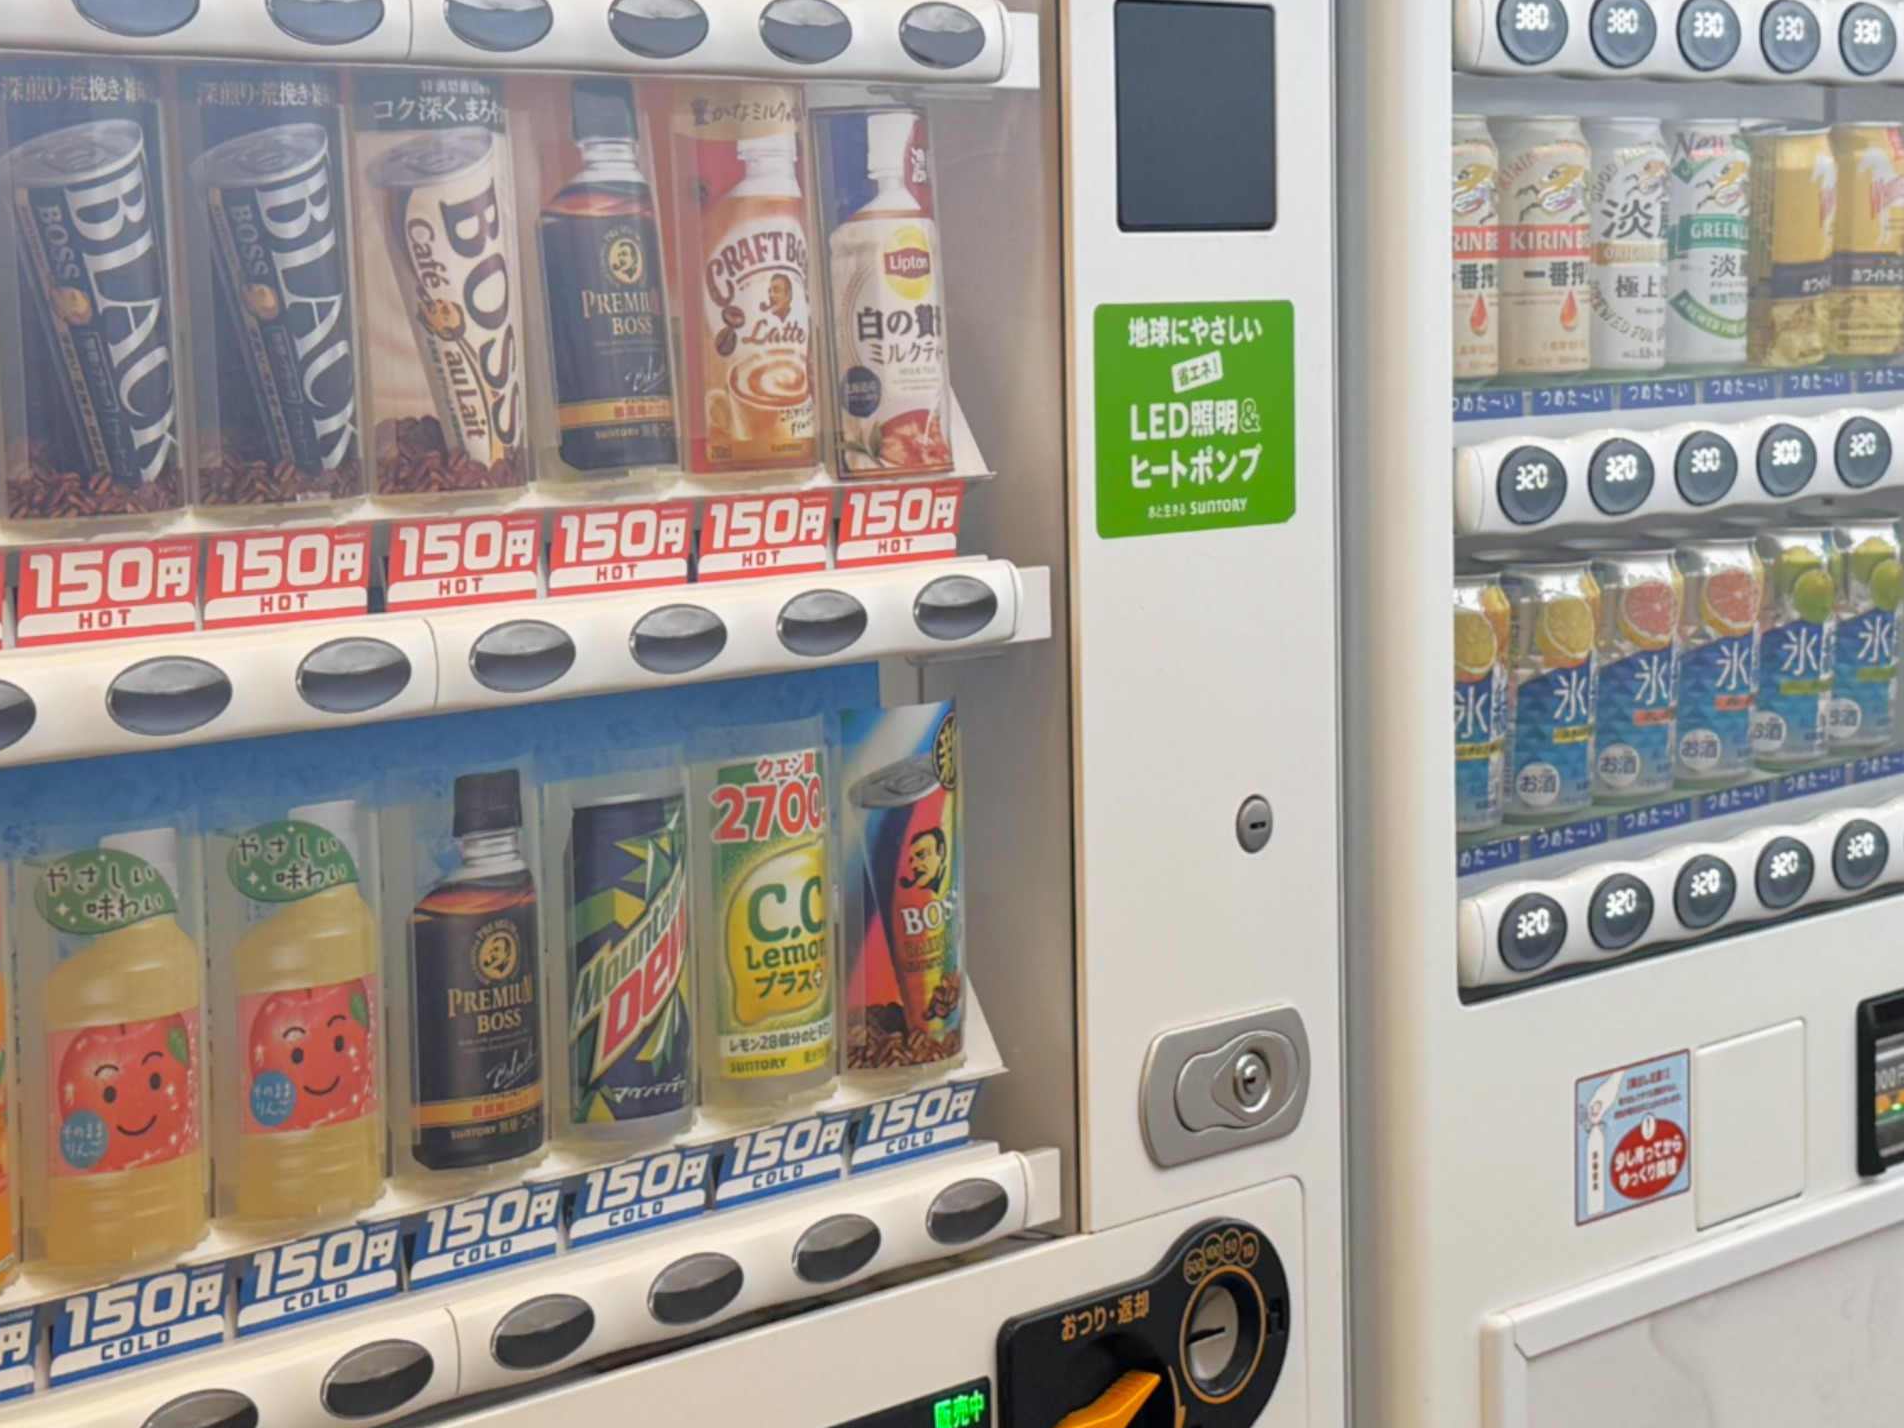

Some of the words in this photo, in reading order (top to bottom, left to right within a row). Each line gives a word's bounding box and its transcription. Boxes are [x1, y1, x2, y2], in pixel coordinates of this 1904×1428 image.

[1514, 2, 1551, 30] 380
[1606, 8, 1640, 34] 380
[1692, 12, 1726, 38] 330
[1774, 17, 1806, 40] 330
[1852, 20, 1882, 44] 330
[34, 203, 82, 280] BOSS
[229, 204, 271, 279] BOSS
[1509, 231, 1574, 250] KIRIN
[406, 218, 451, 292] Café
[888, 254, 930, 272] Lipton
[705, 231, 782, 309] CRAFT
[63, 165, 180, 484] BLACK
[254, 168, 360, 470] BLACK
[439, 176, 522, 447] BOSS
[611, 316, 654, 337] BOSS
[741, 320, 808, 348] Latte
[1128, 315, 1263, 348] 地球にやさしい
[1131, 443, 1263, 489] ヒートポンプ
[1190, 497, 1248, 516] SUNTORY
[741, 548, 782, 568] HOT
[877, 537, 916, 556] HOT
[216, 532, 367, 592] 150円
[596, 562, 639, 583] HOT
[27, 544, 192, 610] 150円
[438, 575, 484, 596] HOT
[258, 590, 312, 613] HOT
[78, 608, 134, 631] HOT
[1680, 738, 1719, 759] お酒
[1599, 754, 1638, 775] お酒
[1518, 773, 1558, 795] お酒
[710, 776, 824, 845] 2700
[238, 836, 342, 862] やさしい
[1846, 832, 1876, 860] 320
[275, 863, 347, 890] 味わい
[1770, 850, 1800, 878] 320
[45, 866, 159, 894] やさしい
[1689, 870, 1721, 898] 320
[85, 892, 165, 922] 味わい
[1604, 889, 1637, 918] 320
[1516, 909, 1550, 938] 320
[448, 974, 534, 1019] PREMIUM
[477, 1008, 522, 1034] BOSS
[729, 1056, 787, 1073] SUNTORY
[252, 1081, 294, 1103] そのまま
[255, 1098, 291, 1118] りんご
[61, 1120, 105, 1145] そのまま
[65, 1138, 104, 1160] りんご
